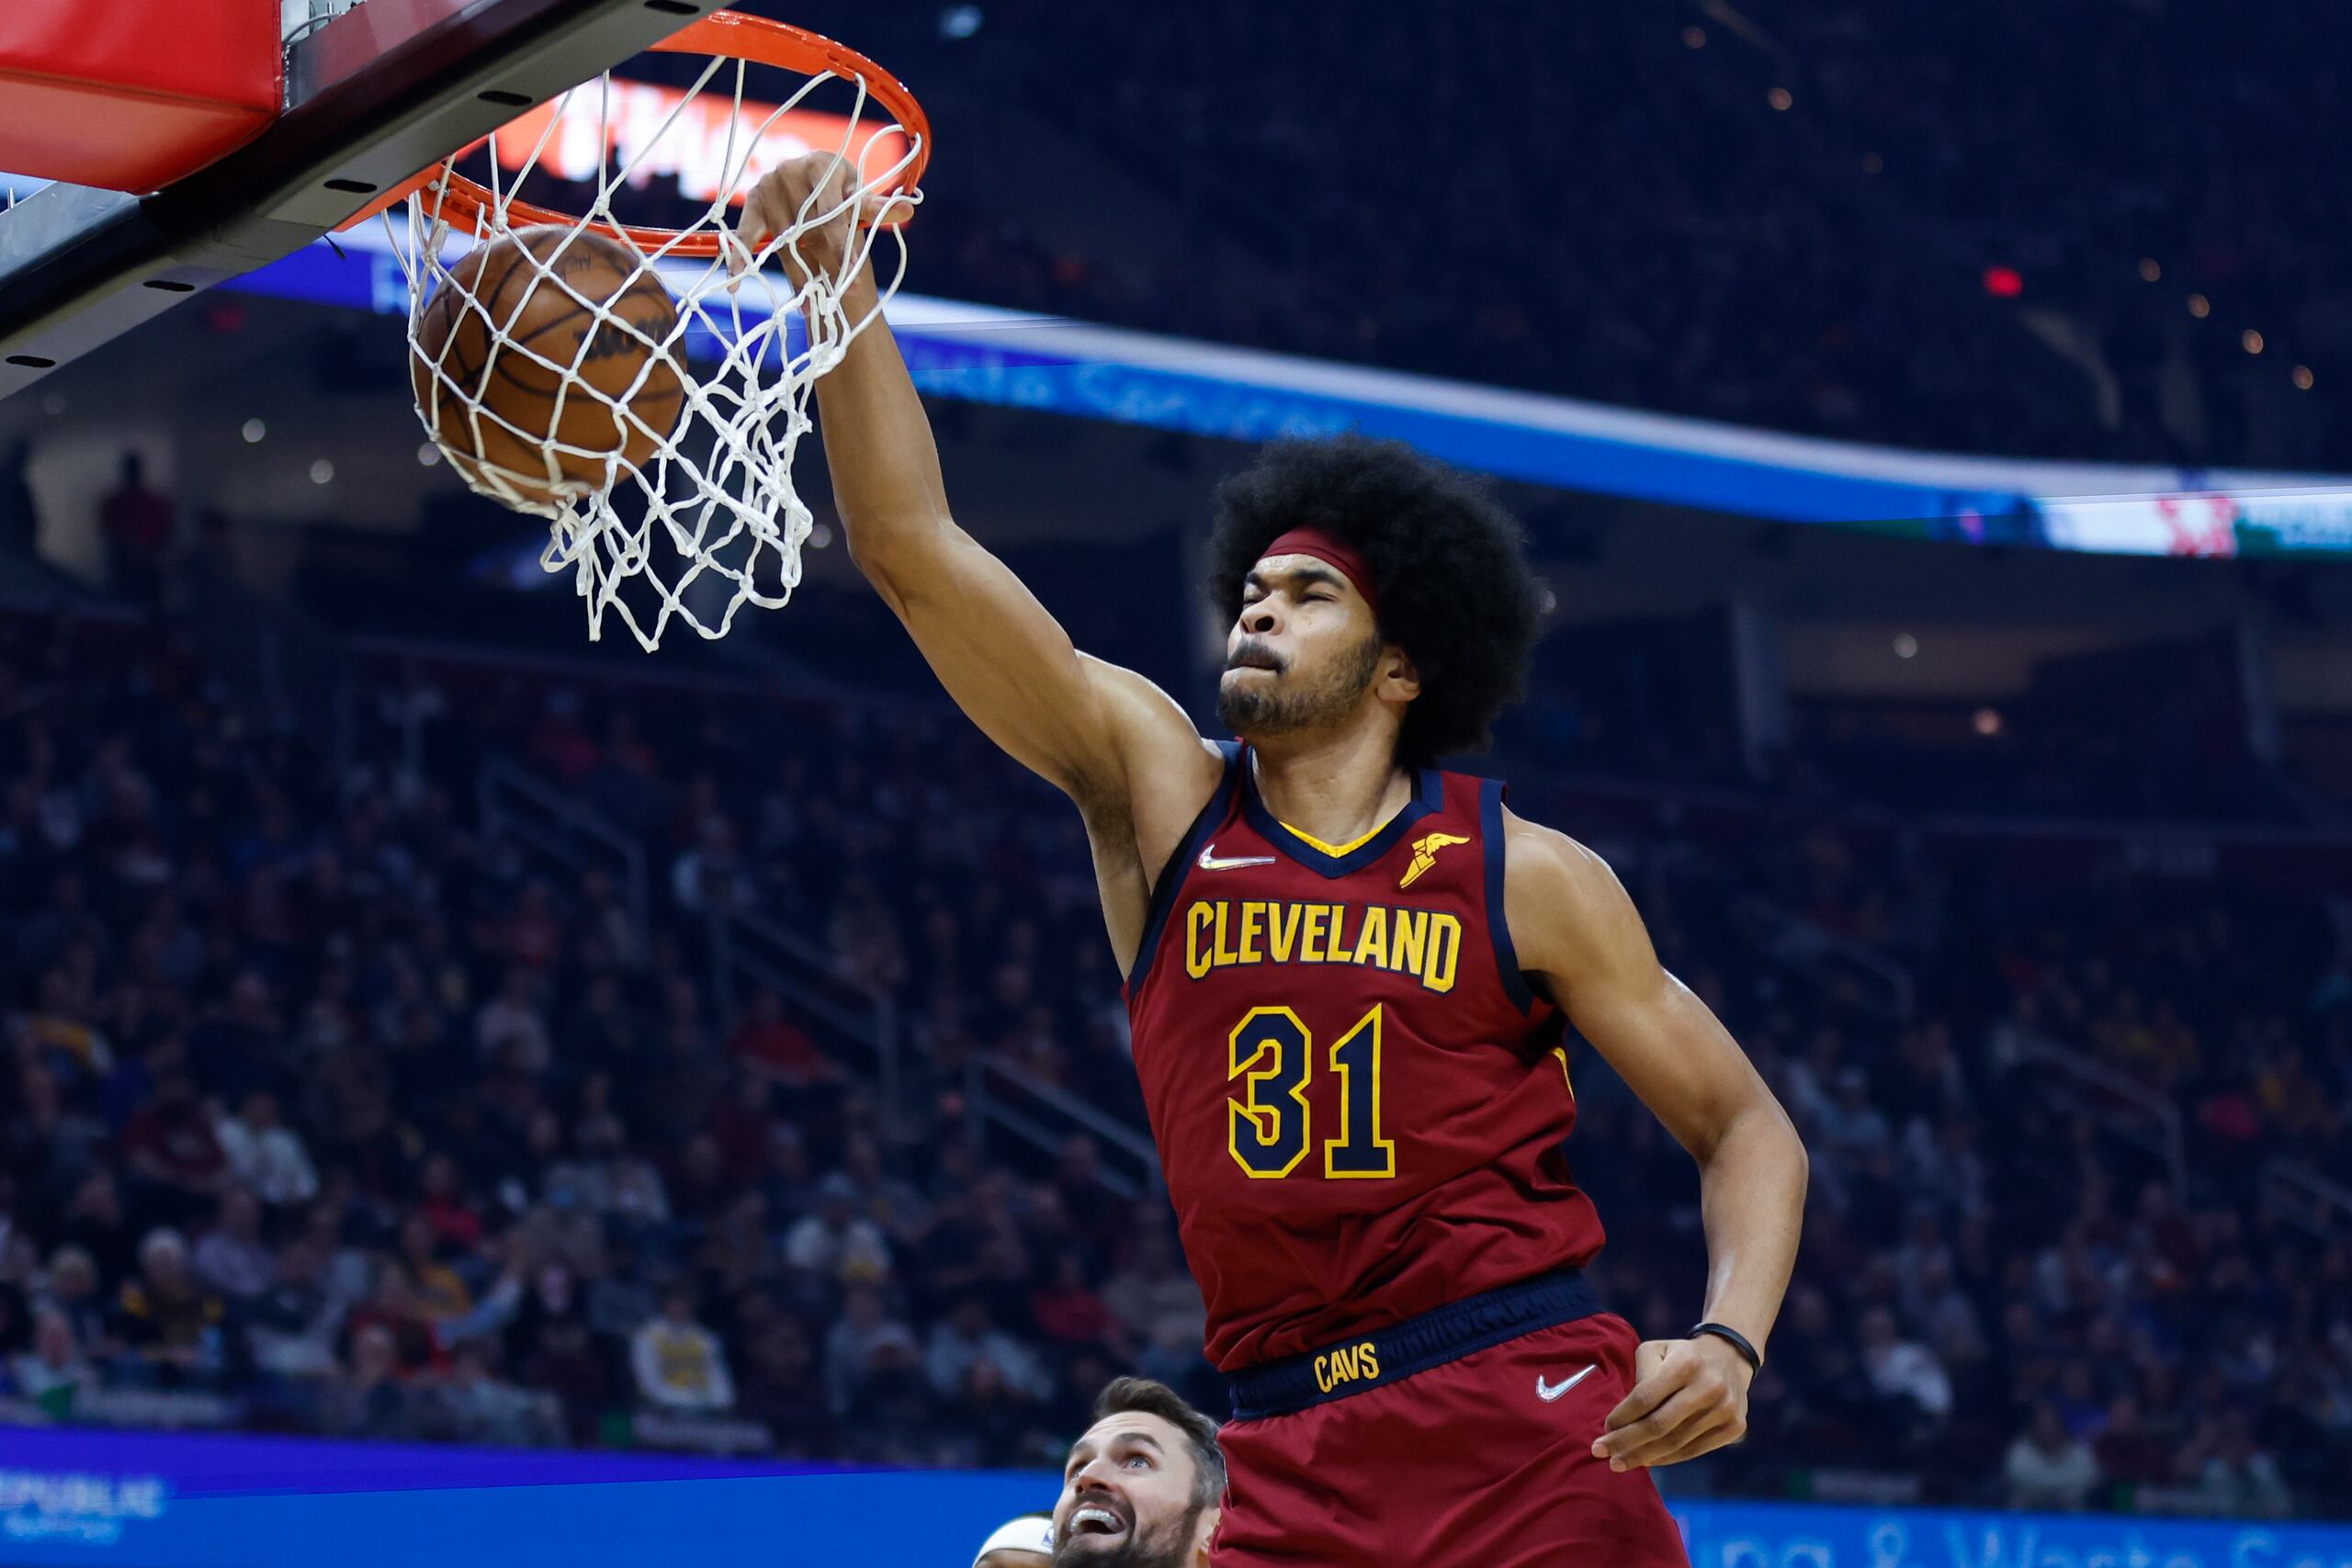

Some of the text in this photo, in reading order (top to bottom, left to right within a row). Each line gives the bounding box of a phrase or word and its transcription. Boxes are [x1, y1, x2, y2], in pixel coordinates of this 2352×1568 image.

[1185, 899, 1463, 995] CLEVELAND
[1227, 1002, 1396, 1179] 31
[1313, 1342, 1380, 1393] CAVS
